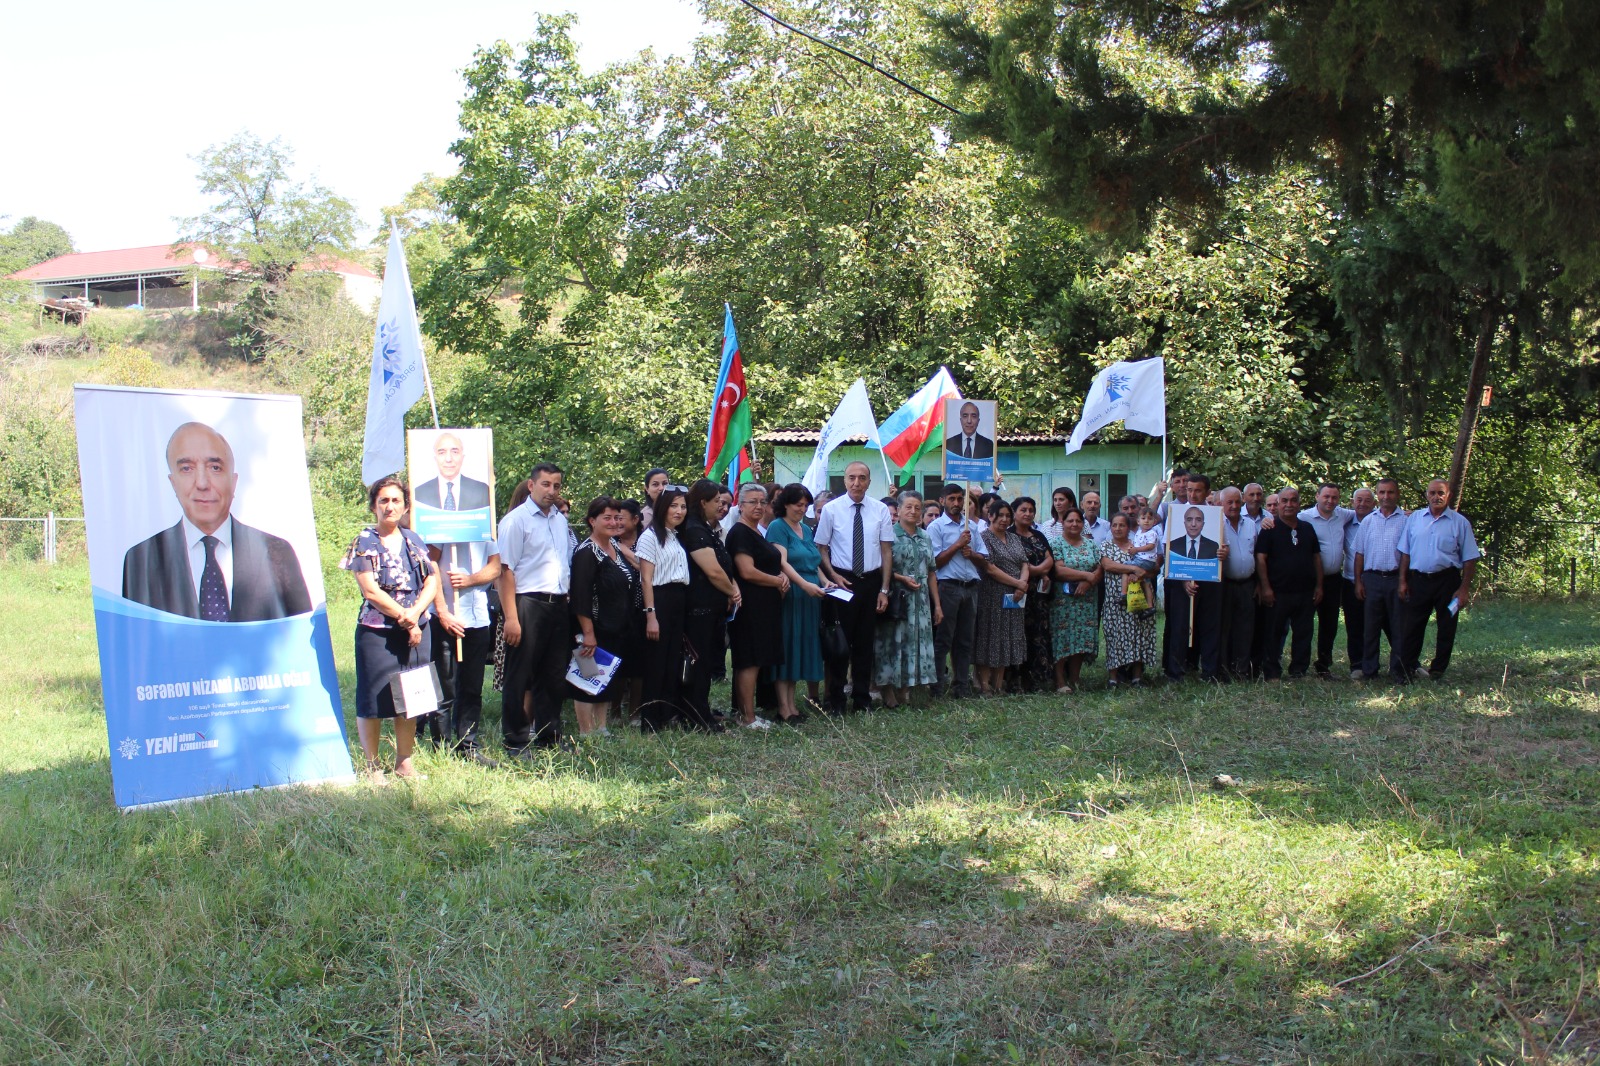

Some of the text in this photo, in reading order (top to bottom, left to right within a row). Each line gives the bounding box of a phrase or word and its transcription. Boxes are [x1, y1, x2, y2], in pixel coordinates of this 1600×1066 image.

[136, 682, 190, 701] SƏFƏROV
[193, 675, 233, 696] NİZAMİ
[234, 673, 283, 692] ABDULLA
[145, 732, 178, 756] YENİ
